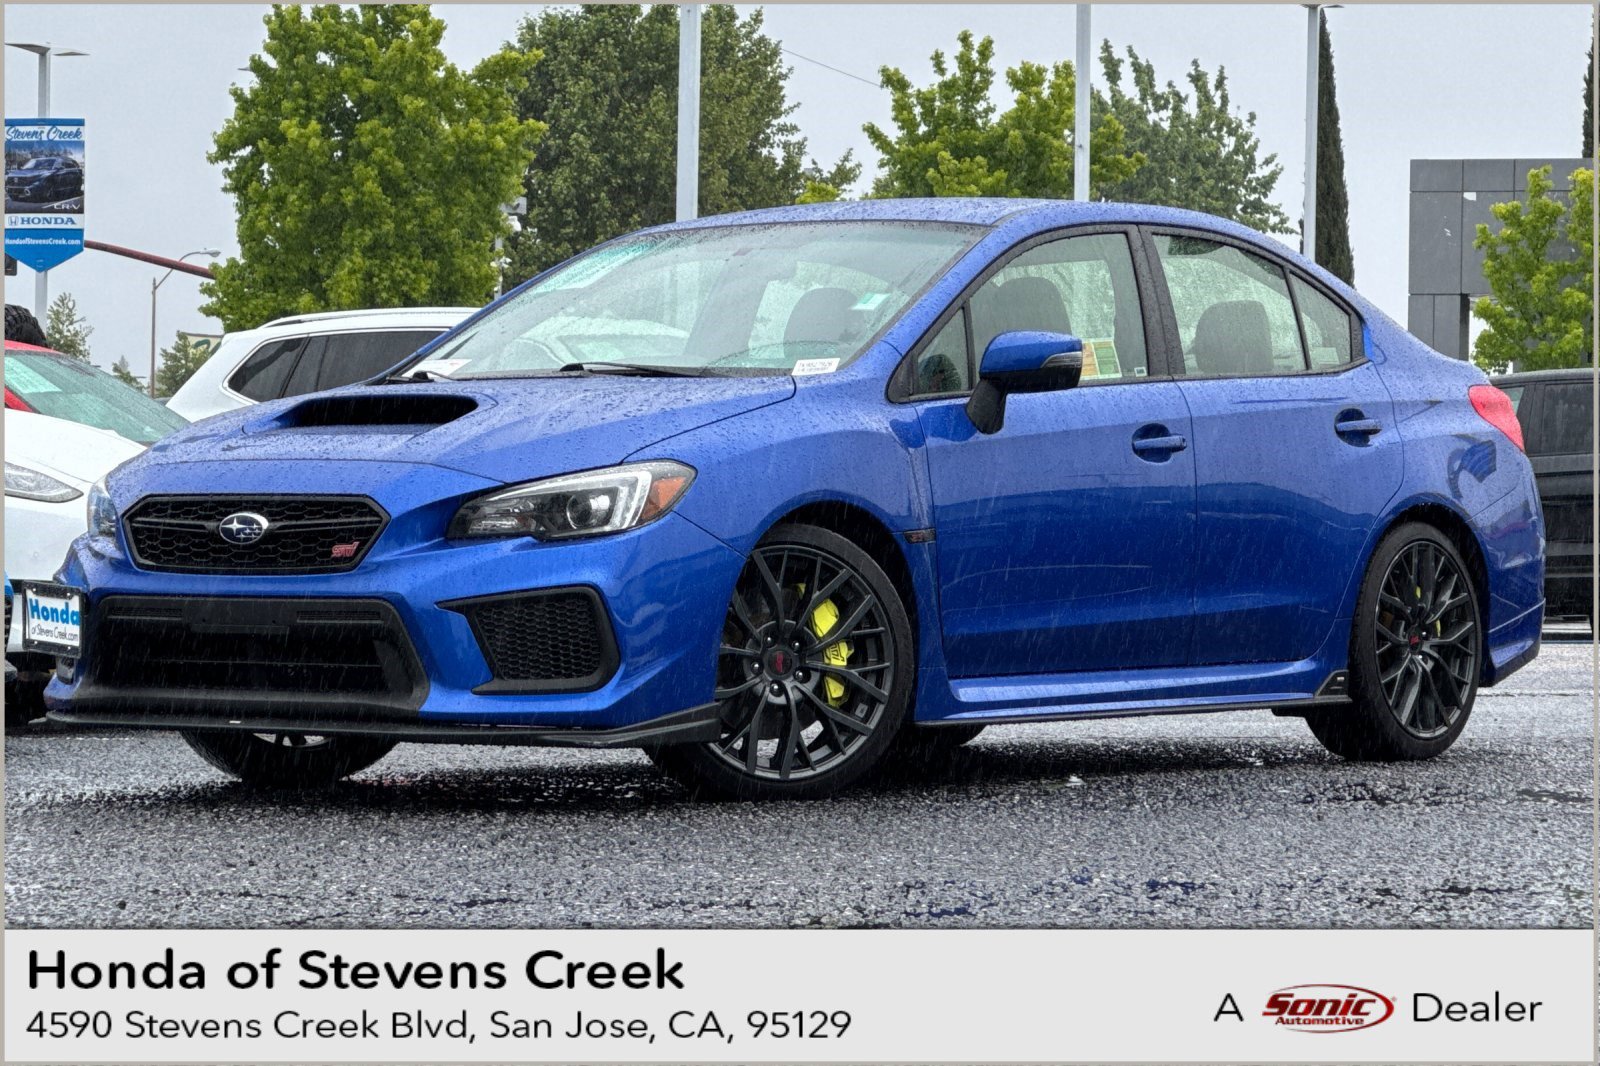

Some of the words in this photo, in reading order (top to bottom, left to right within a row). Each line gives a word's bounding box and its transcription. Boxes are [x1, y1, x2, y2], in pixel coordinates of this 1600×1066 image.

[6, 126, 44, 141] Stevens
[47, 125, 82, 140] Creek
[20, 217, 76, 225] HONDA
[5, 237, 81, 245] HondaofStevensCreek.com
[29, 598, 80, 626] Honda
[37, 623, 53, 638] Stevens
